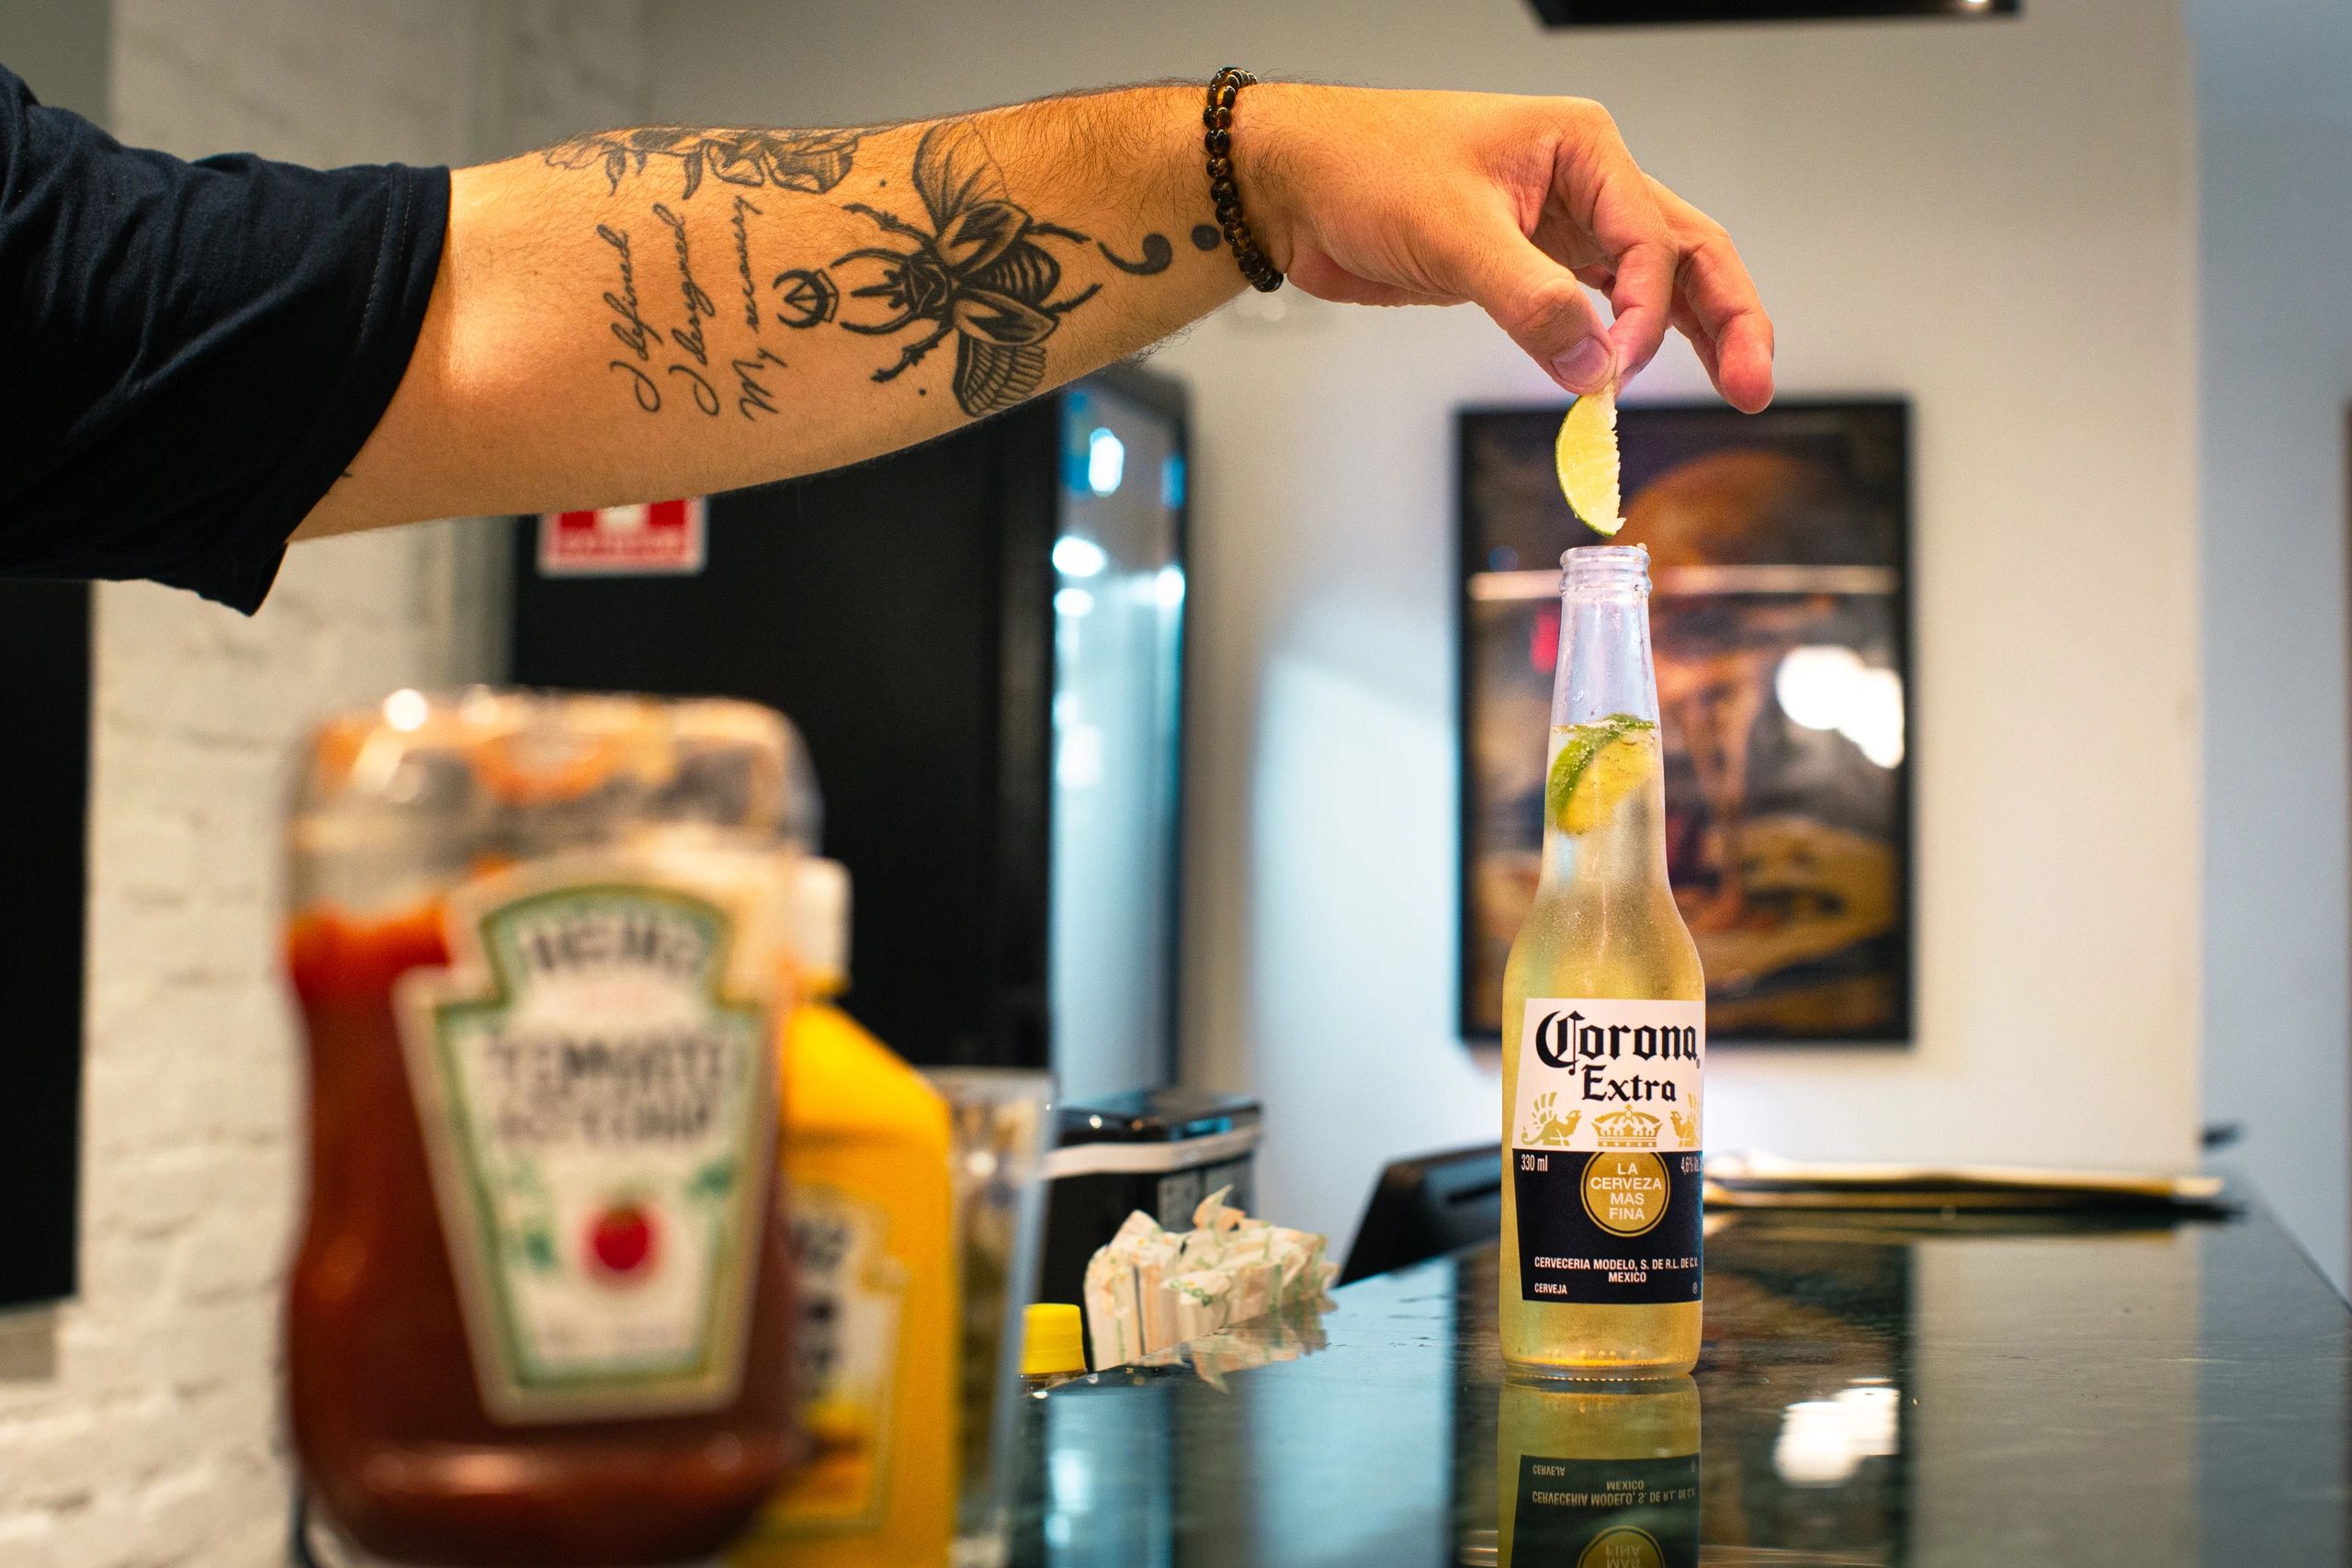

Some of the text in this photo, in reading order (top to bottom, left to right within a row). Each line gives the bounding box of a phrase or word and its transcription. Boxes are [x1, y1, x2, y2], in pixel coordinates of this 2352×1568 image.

[652, 202, 717, 366] designed
[597, 224, 663, 361] defined
[731, 195, 790, 423] My recovery
[1535, 1010, 1698, 1077] Corona
[1581, 1064, 1677, 1102] Extra
[1521, 1155, 1549, 1172] 330 ml
[1617, 1162, 1638, 1176] LA
[1589, 1177, 1662, 1190] CERVEZA
[1610, 1192, 1645, 1205] MAS
[1609, 1207, 1645, 1221] FINA
[1534, 1257, 1590, 1270] CERVECERIA
[1593, 1258, 1638, 1272] MODELO,
[1640, 1259, 1650, 1270] S.
[1652, 1258, 1664, 1270] DE
[1665, 1258, 1679, 1269] R.L.
[1680, 1258, 1689, 1269] DE
[1608, 1271, 1647, 1283] MEXICO
[1534, 1282, 1567, 1295] CERVEJA
